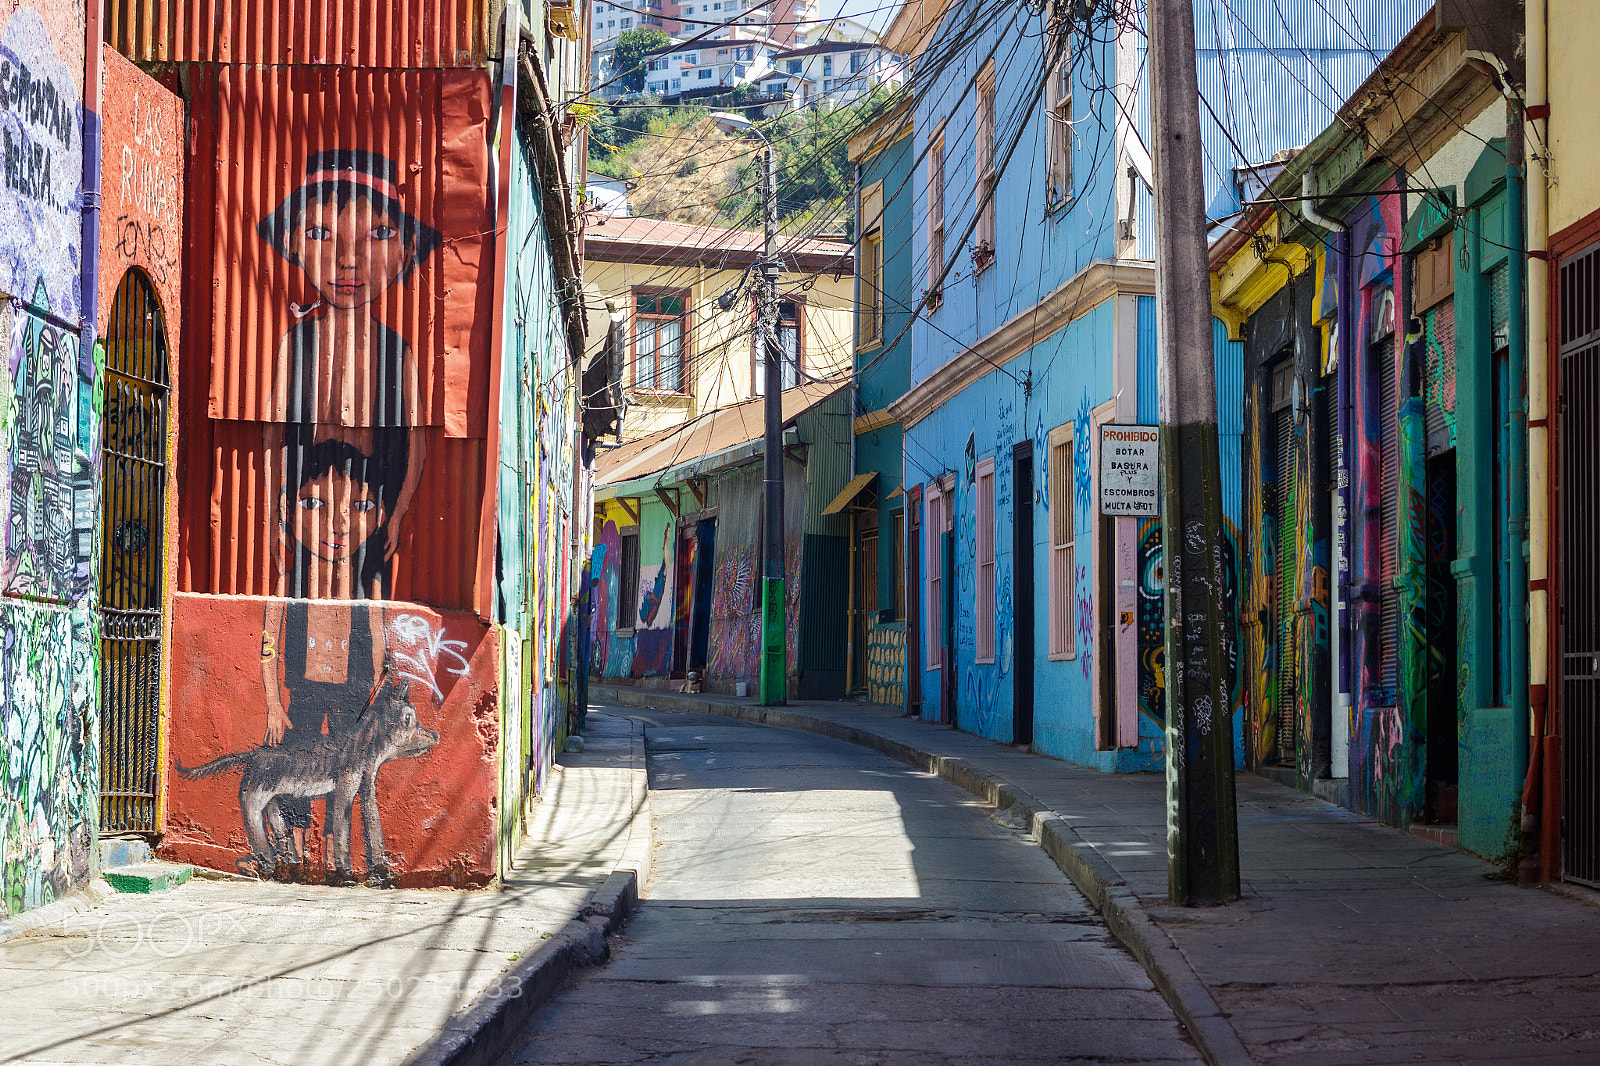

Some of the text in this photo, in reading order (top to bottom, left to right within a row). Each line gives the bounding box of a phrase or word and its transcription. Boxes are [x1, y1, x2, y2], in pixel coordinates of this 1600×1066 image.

[134, 92, 163, 157] LAS
[120, 142, 177, 225] RUINAS
[1103, 430, 1158, 442] PROHIBIDO
[1115, 448, 1145, 456] BOTAR
[1111, 461, 1149, 470] BASURA
[1127, 476, 1132, 484] Y
[1104, 488, 1155, 497] ESCOMBROS
[1105, 502, 1131, 510] MULTA
